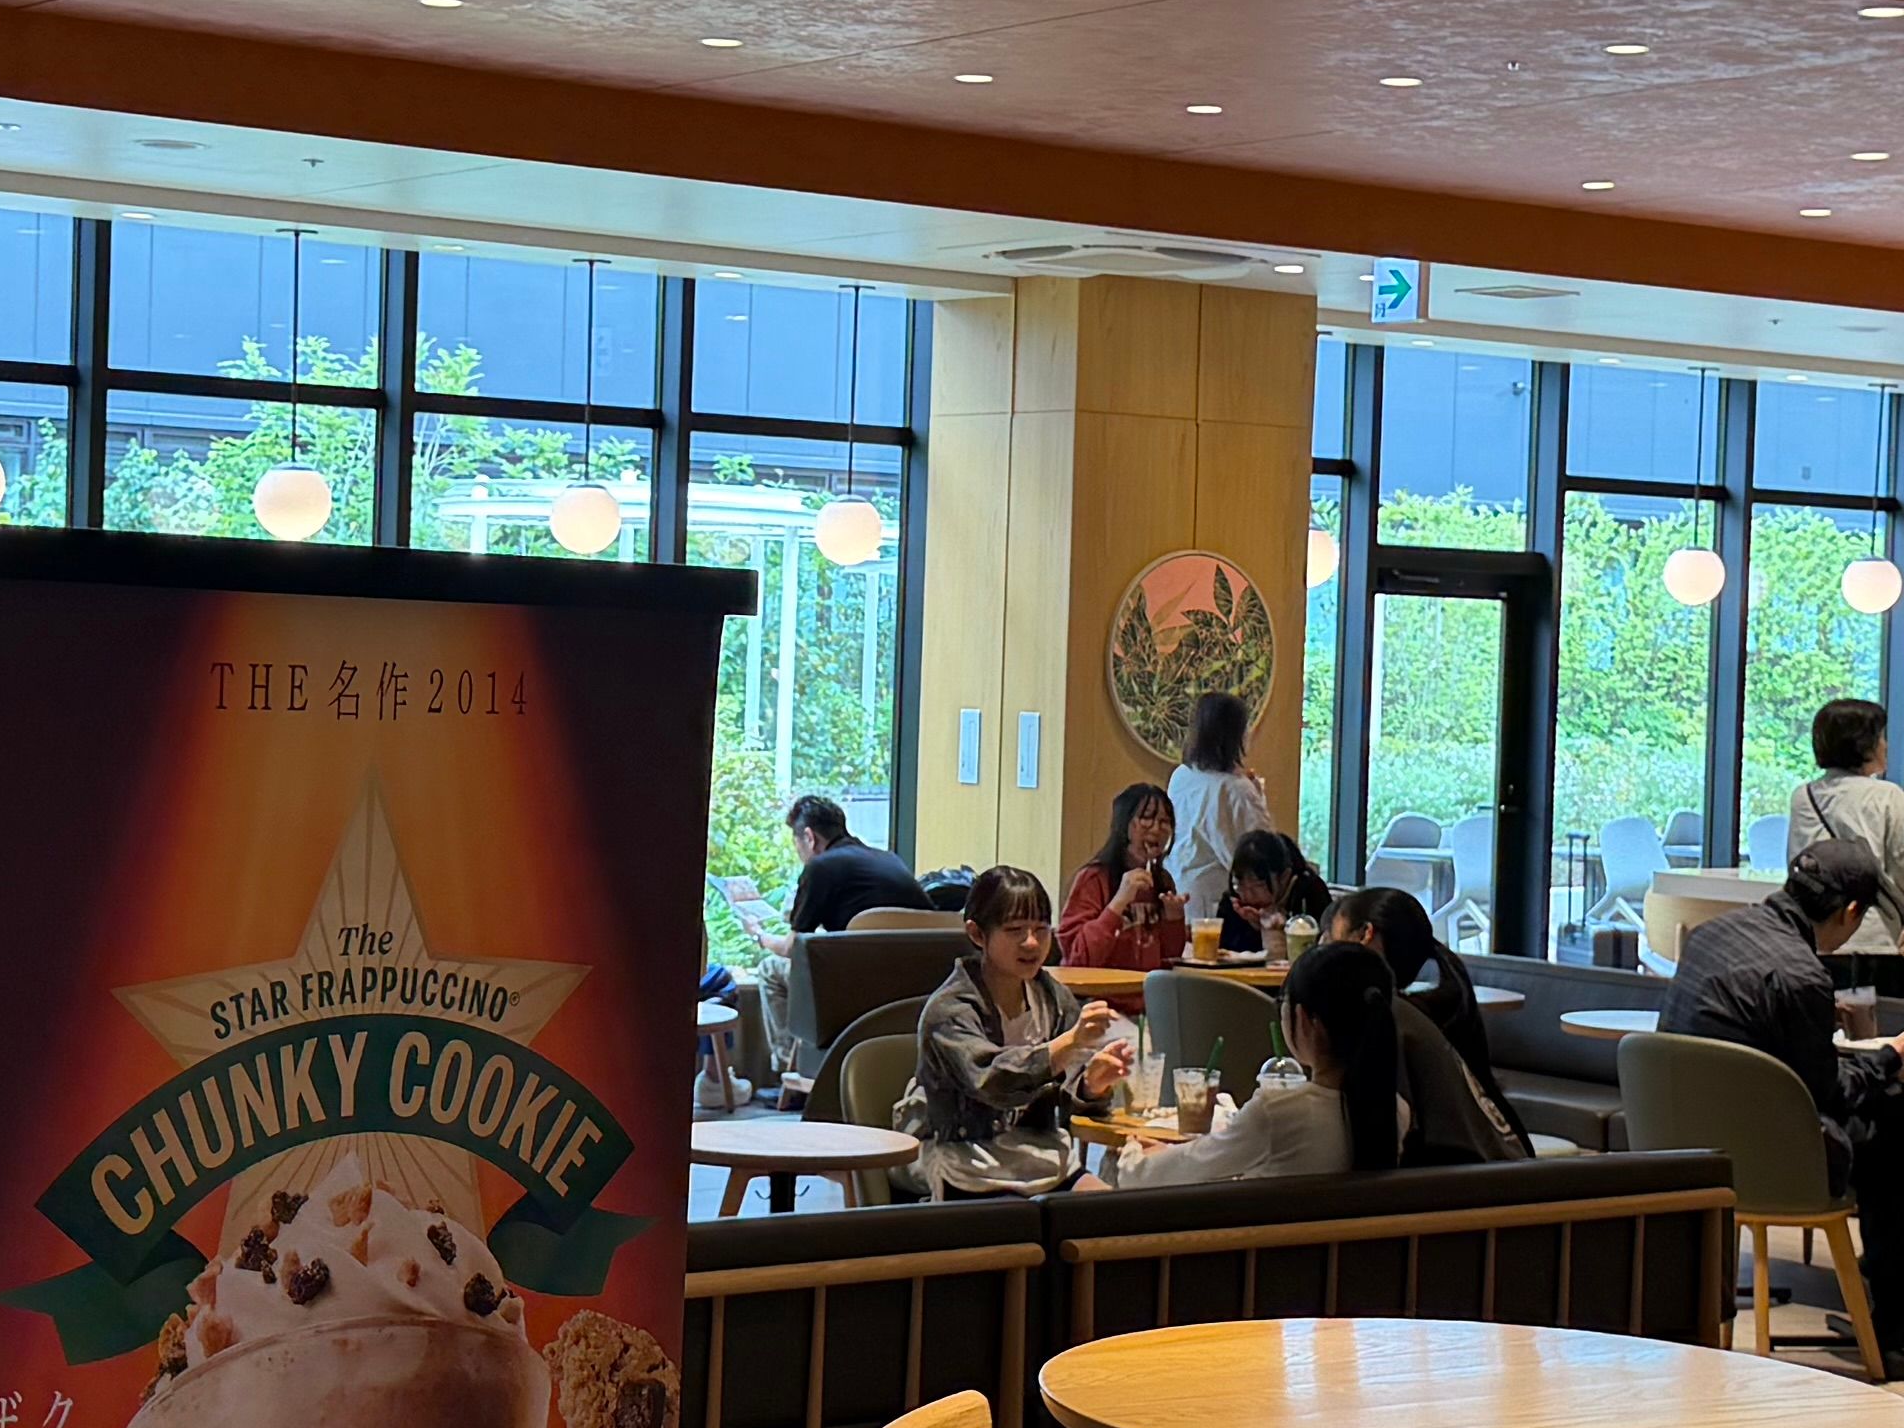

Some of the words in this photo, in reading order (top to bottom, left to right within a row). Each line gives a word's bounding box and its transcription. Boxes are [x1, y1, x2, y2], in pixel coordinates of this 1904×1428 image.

[337, 922, 395, 960] The
[209, 979, 291, 1042] STAR
[90, 1030, 366, 1237] CHUNKY
[389, 1030, 604, 1198] COOKIE
